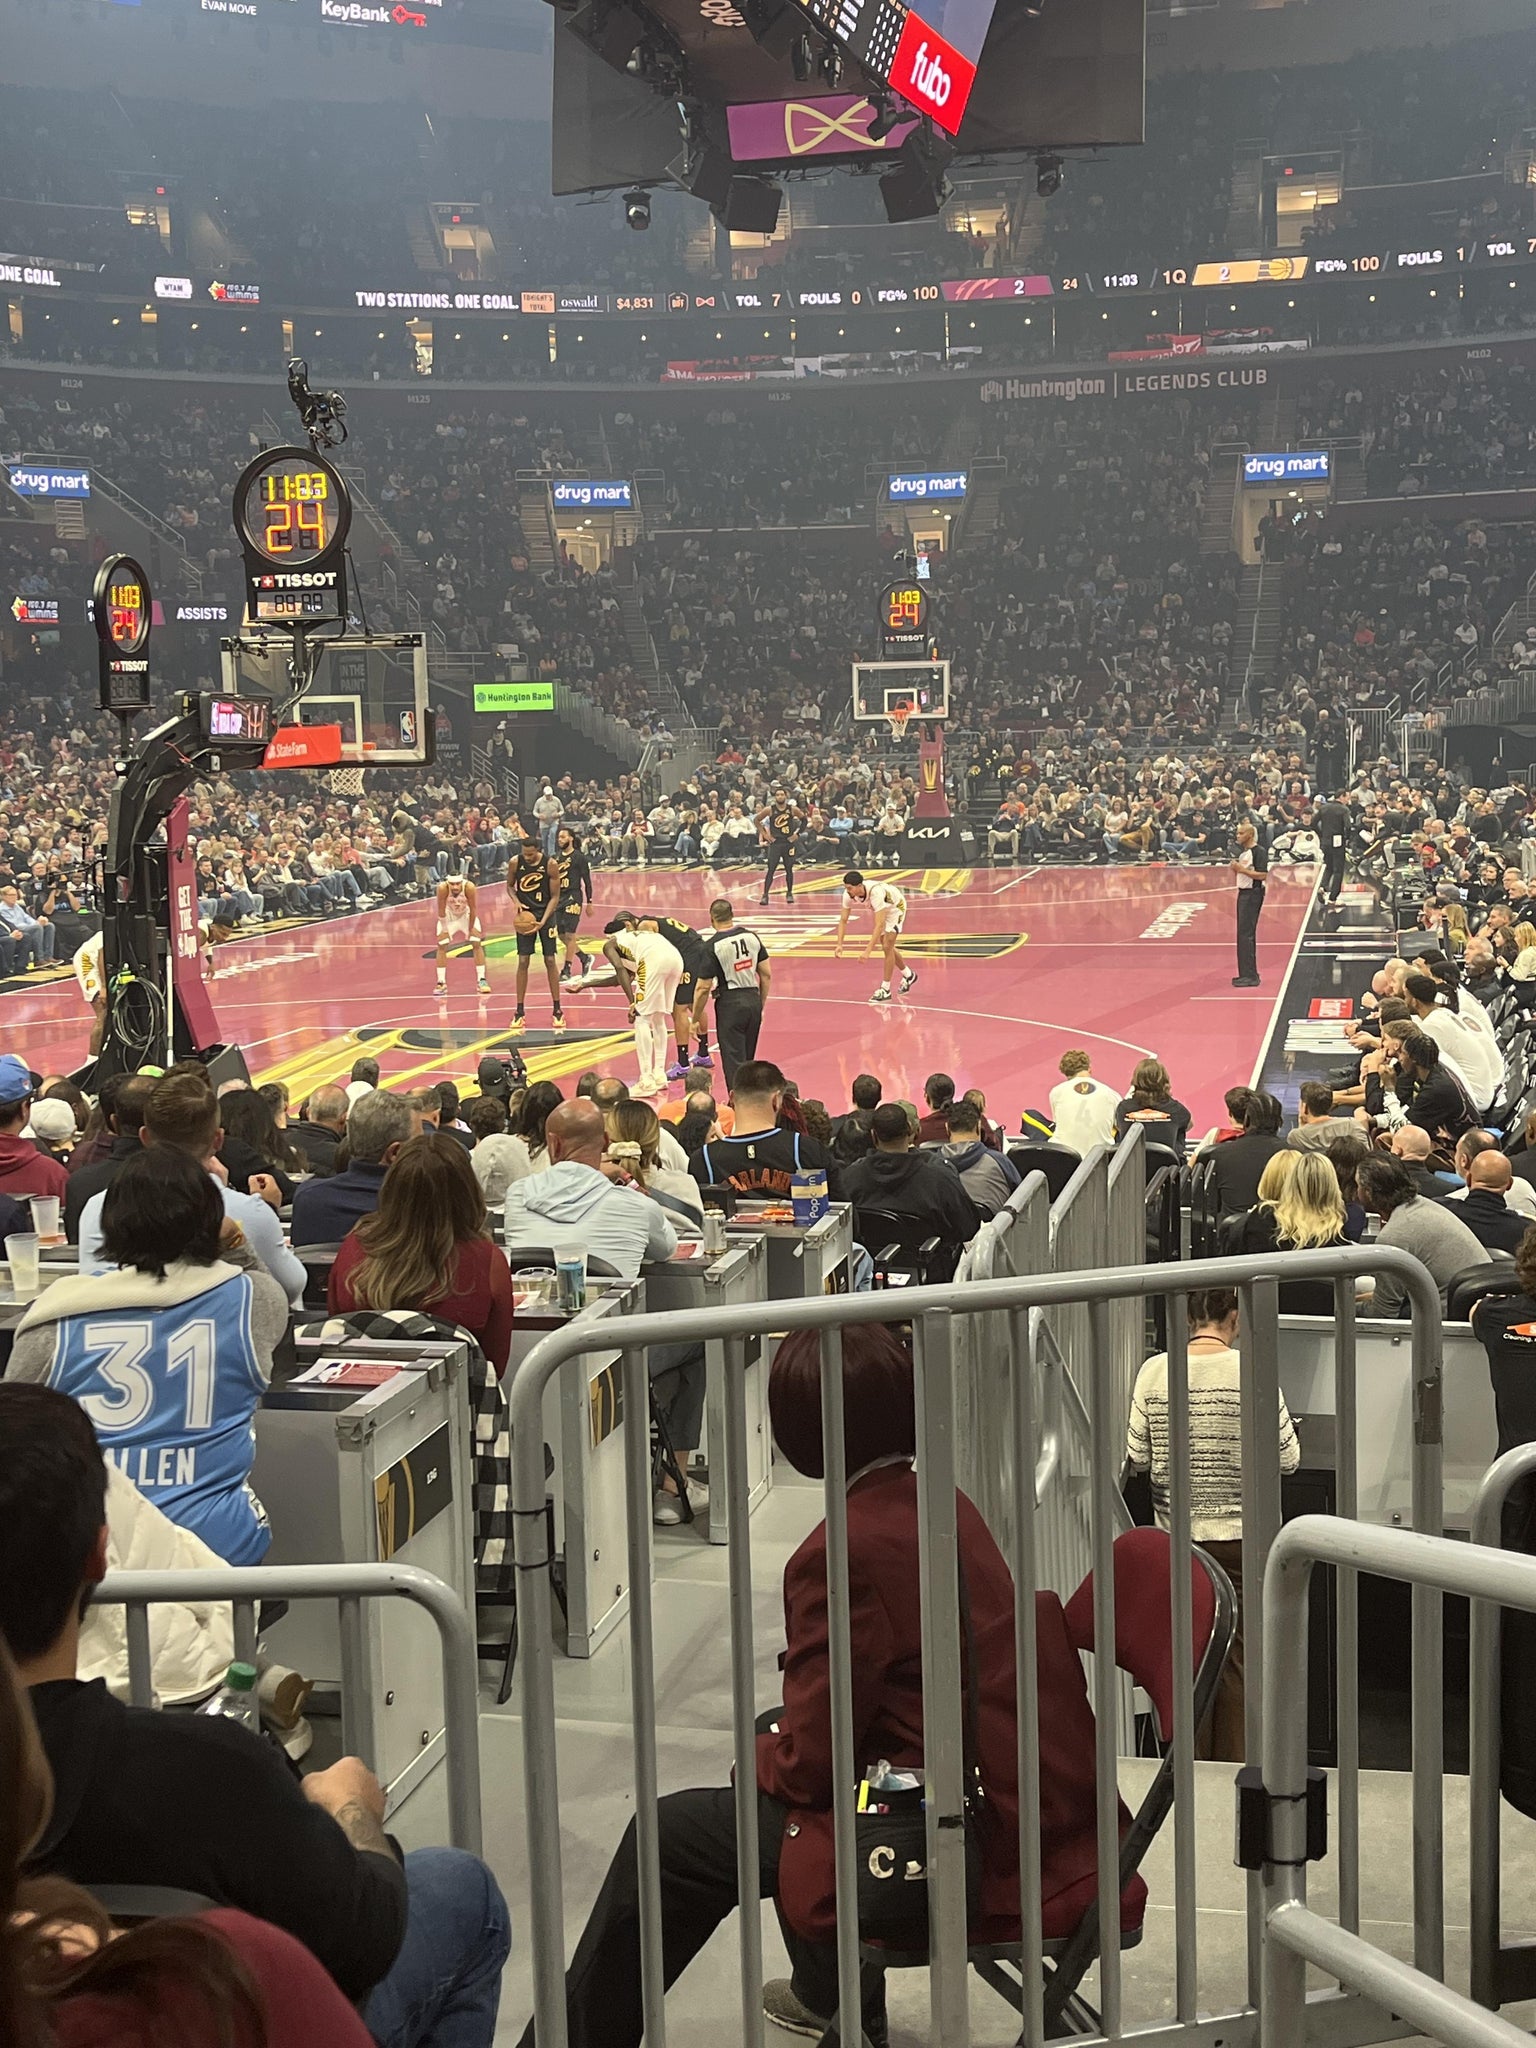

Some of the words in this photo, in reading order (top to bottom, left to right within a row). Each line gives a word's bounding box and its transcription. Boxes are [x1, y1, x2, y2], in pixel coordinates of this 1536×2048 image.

[201, 1, 227, 12] EVAN
[229, 3, 257, 15] MOVE
[321, 0, 390, 23] KeyBank
[909, 42, 951, 107] fubo
[1315, 259, 1347, 274] FG%
[1351, 257, 1380, 272] 100
[1397, 250, 1443, 267] FOULS
[1457, 247, 1465, 262] 1
[1487, 243, 1516, 257] TOL
[0, 266, 22, 282] ONE
[24, 268, 61, 286] GOAL.
[1062, 278, 1078, 290] 24
[1103, 273, 1139, 288] 11:03
[1162, 269, 1187, 285] 1Q
[1218, 266, 1231, 281] 2
[736, 295, 762, 307] TOL
[772, 294, 782, 307] 7
[800, 293, 842, 306] FOULS
[851, 291, 861, 305] 0
[878, 290, 908, 302] FG%
[912, 287, 938, 301] 100
[1014, 280, 1026, 295] 2
[355, 291, 385, 307] TWO
[387, 293, 453, 309] STATIONS.
[455, 294, 481, 309] ONE
[483, 295, 519, 310] GOAL.
[560, 295, 599, 308] oswald
[616, 297, 654, 310] $4,831
[1007, 379, 1106, 401] Huntington
[1125, 373, 1211, 393] LEGENDS
[1216, 369, 1268, 387] CLUB
[1245, 458, 1284, 476] drug
[1287, 454, 1328, 471] mart
[10, 470, 48, 491] drug
[51, 475, 89, 489] mart
[268, 473, 328, 501] 11:03
[890, 478, 927, 495] drug
[929, 475, 966, 490] mart
[554, 485, 591, 503] drug
[594, 486, 630, 499] mart
[265, 502, 325, 552] 24
[274, 572, 337, 587] TISSOT
[891, 591, 920, 604] 11:03
[177, 607, 227, 620] ASSISTS
[889, 604, 919, 627] 24
[111, 610, 137, 641] 24
[895, 634, 924, 642] TISSOT
[121, 660, 148, 671] TISSOT
[487, 693, 530, 703] Huntington
[532, 692, 552, 701] Bank
[908, 826, 950, 839] KIA
[730, 938, 750, 959] 74
[79, 1319, 215, 1431] 31
